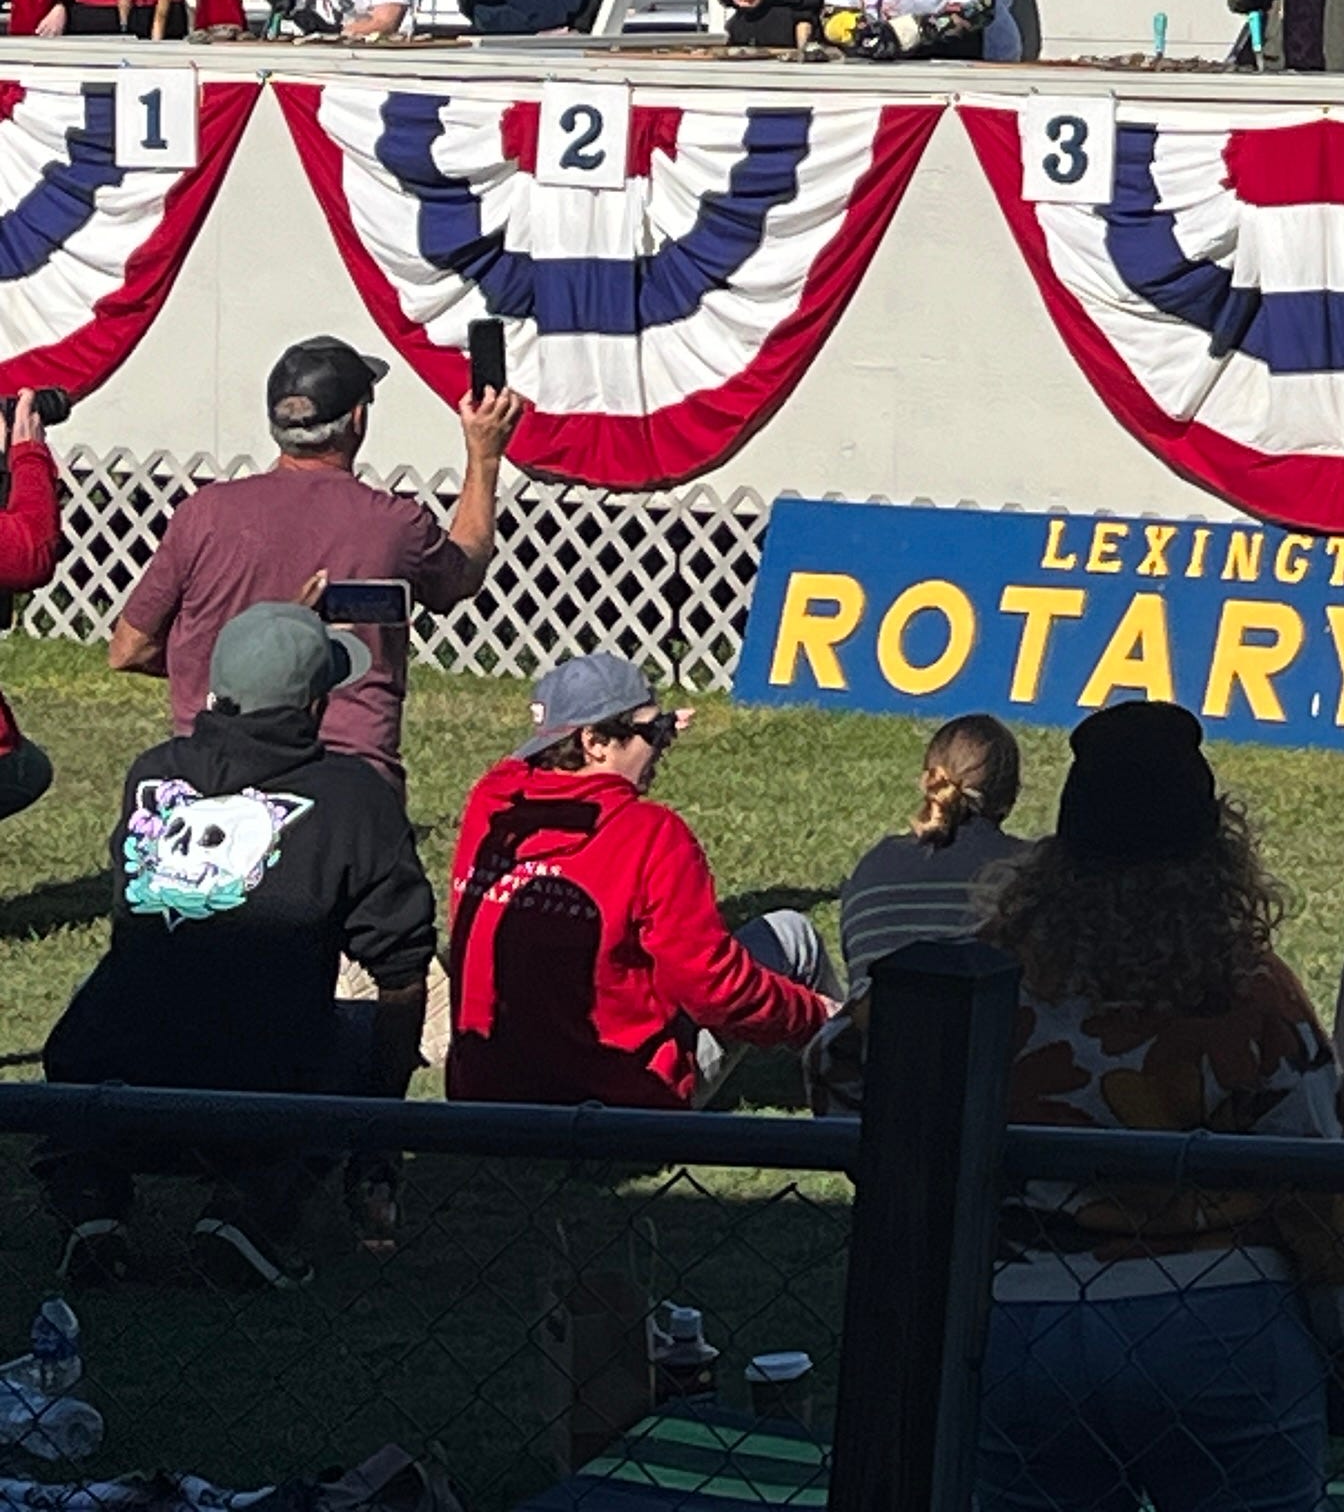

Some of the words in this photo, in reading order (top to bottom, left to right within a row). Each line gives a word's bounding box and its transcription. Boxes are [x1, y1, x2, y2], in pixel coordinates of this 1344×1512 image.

[138, 86, 168, 150] 1
[558, 102, 607, 172] 2
[1042, 114, 1089, 185] 3
